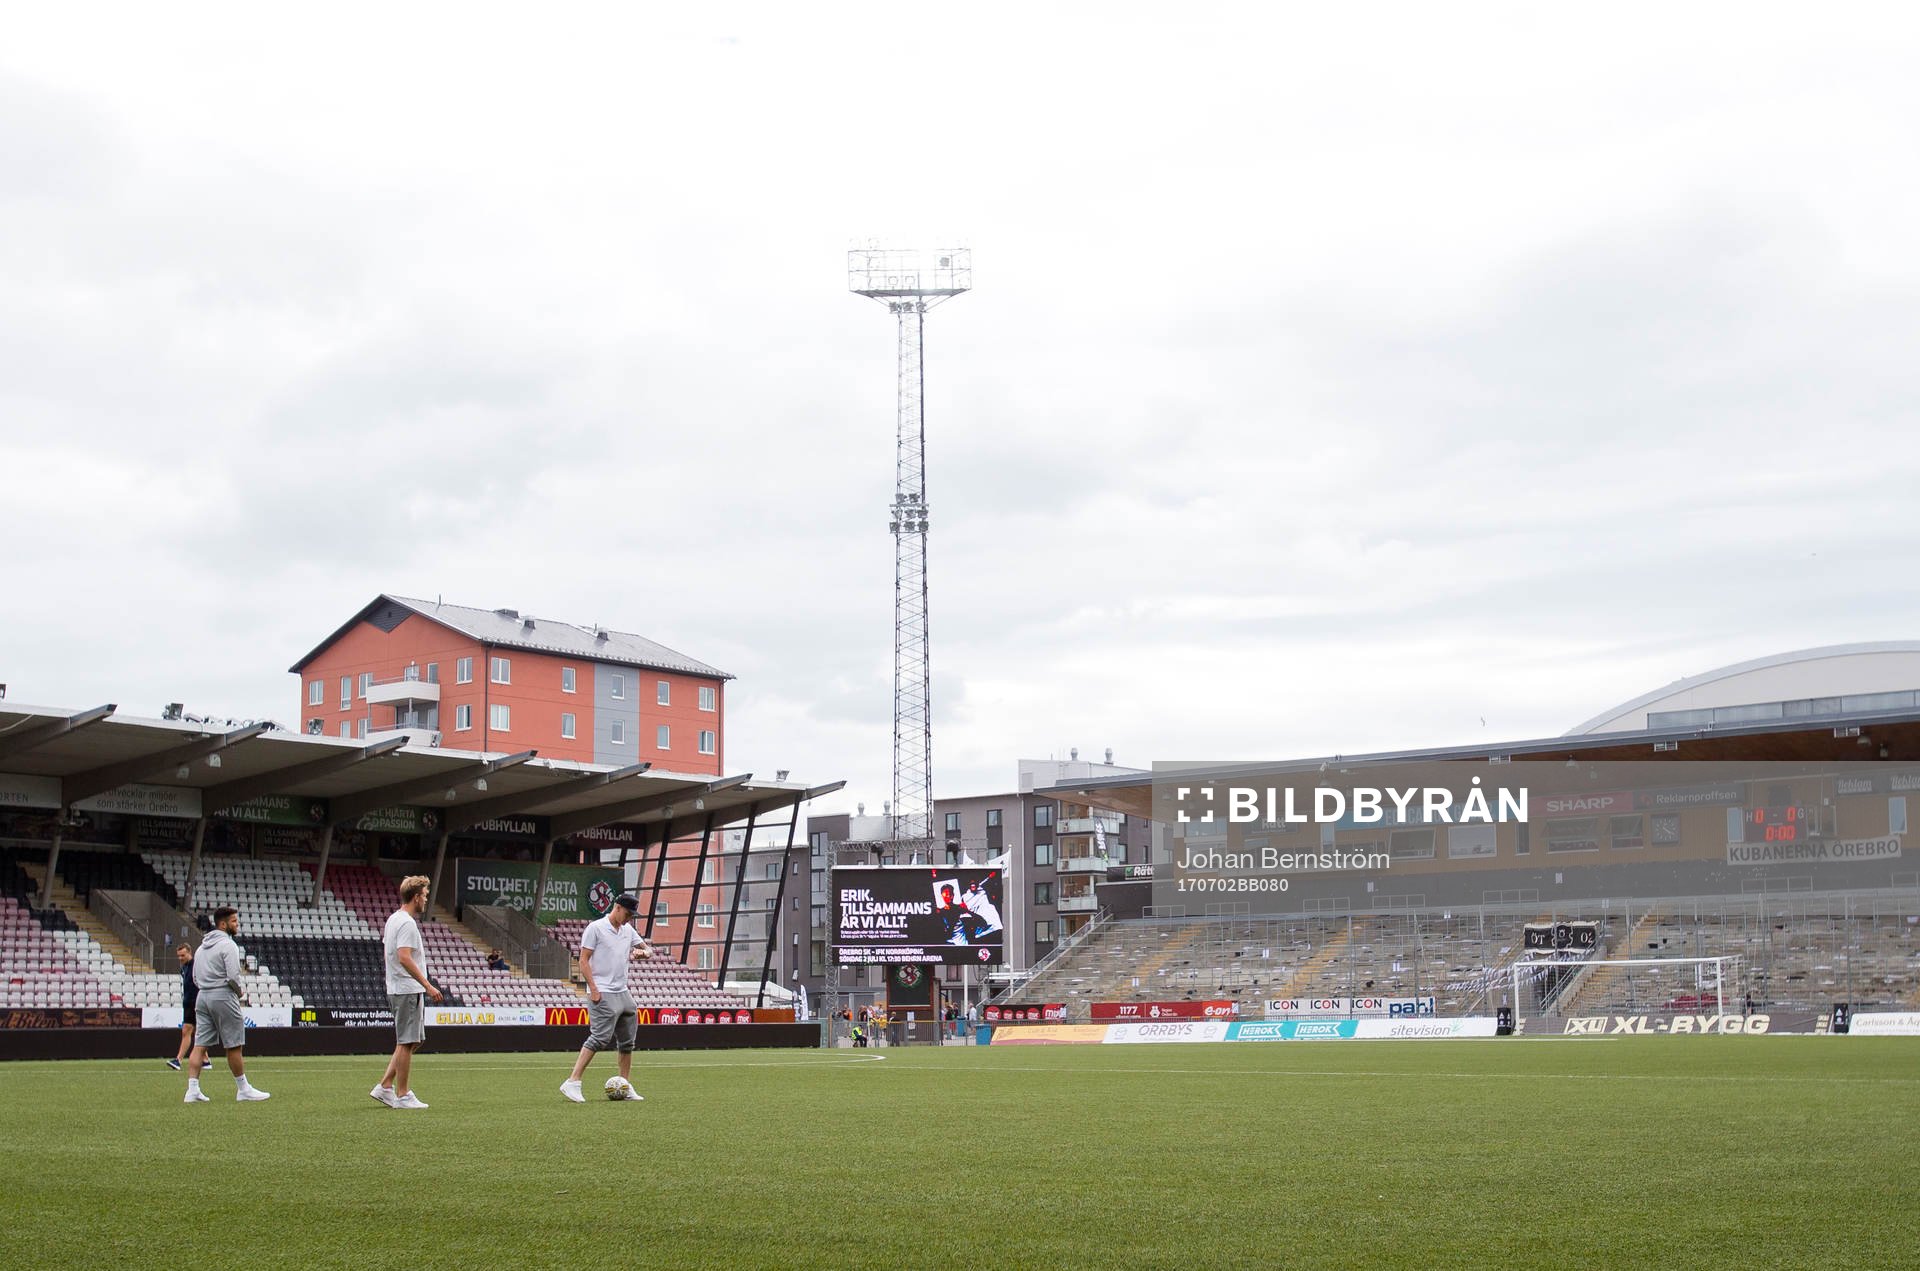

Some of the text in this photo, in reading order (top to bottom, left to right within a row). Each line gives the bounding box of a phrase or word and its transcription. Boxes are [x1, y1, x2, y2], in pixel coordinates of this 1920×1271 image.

[1546, 797, 1614, 812] SHARP
[380, 818, 415, 831] PASSION
[1730, 838, 1899, 862] KUBANERNA ÖREBRO
[840, 889, 874, 902] ERIK.
[840, 902, 932, 915] TILLSAMMANS
[840, 913, 908, 928] ÄR VI ALLT.
[1269, 1000, 1299, 1010] ICON
[1310, 1000, 1340, 1010] ICON
[1352, 999, 1382, 1009] ICON
[331, 1011, 338, 1019] Vi
[339, 1011, 368, 1019] levererar
[475, 1012, 495, 1025] AB
[1138, 1024, 1194, 1036] ORRBYS
[1241, 1026, 1275, 1035] HEROK
[1299, 1025, 1333, 1034] HEROK
[1390, 1024, 1451, 1037] sitevision
